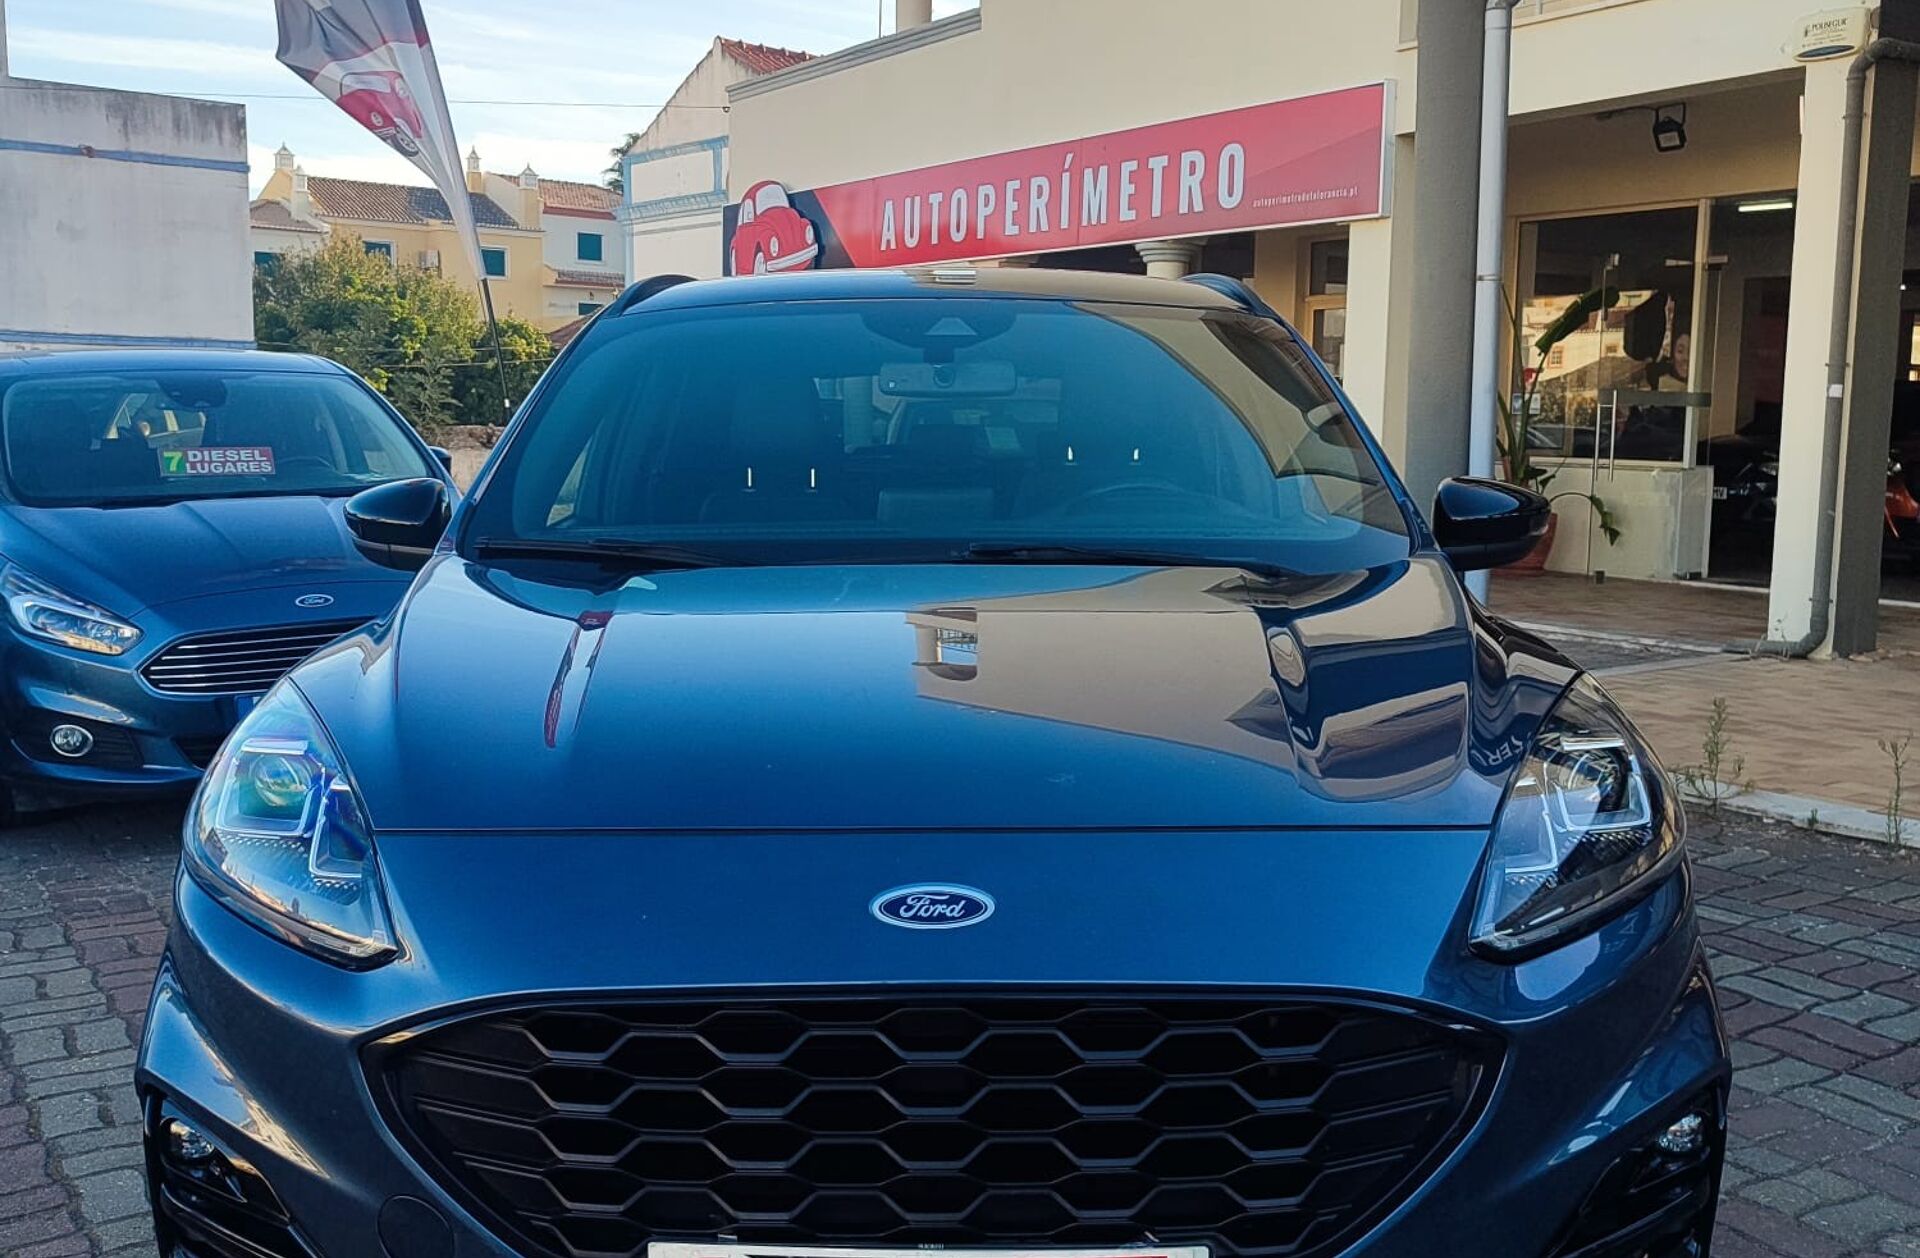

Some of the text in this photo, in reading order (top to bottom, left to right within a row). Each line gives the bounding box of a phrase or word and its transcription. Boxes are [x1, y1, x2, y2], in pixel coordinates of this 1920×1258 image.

[880, 143, 1245, 251] AUTOPERÍMETRO
[163, 449, 267, 472] 7 DIESEL
[186, 461, 273, 474] LUGARES
[899, 894, 966, 918] Ford
